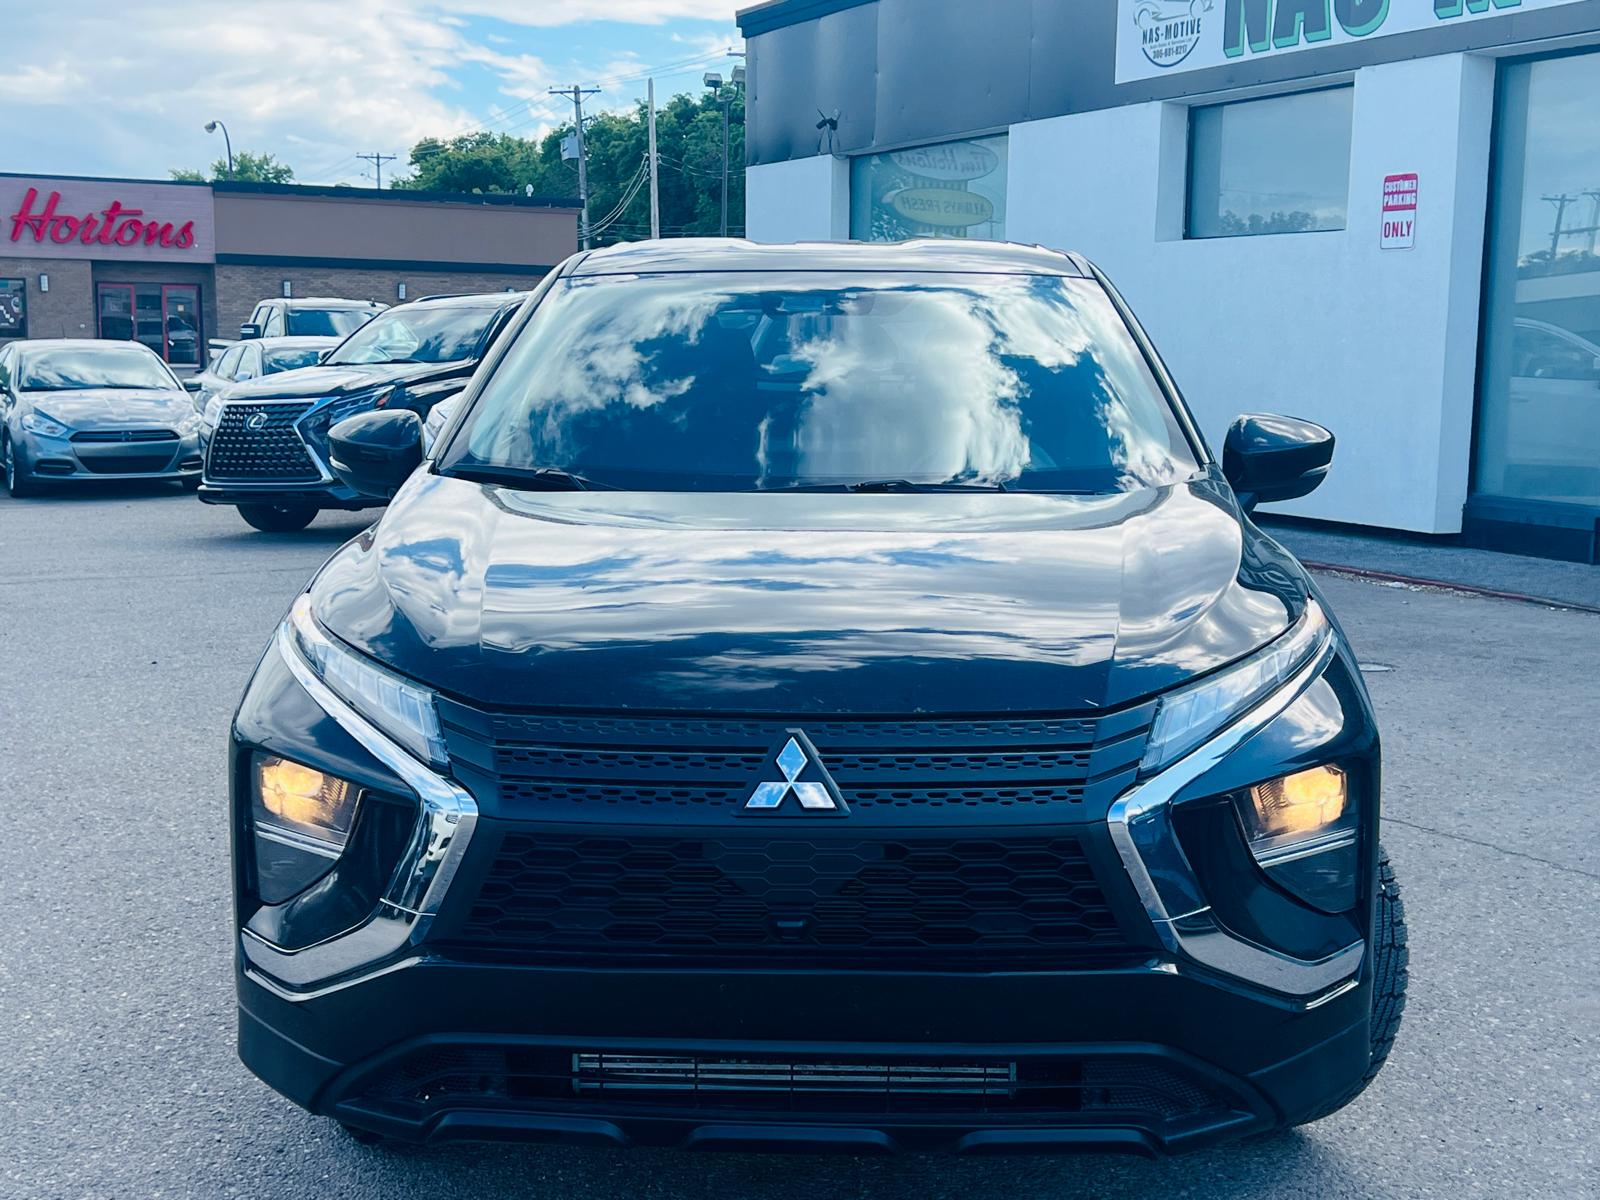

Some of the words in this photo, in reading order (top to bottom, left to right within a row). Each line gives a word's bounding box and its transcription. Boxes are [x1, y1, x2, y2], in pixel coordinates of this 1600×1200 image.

[1142, 17, 1201, 45] NAS-MOTIVE
[1384, 192, 1416, 206] PARKING
[11, 187, 195, 249] Hortons
[1384, 221, 1412, 238] ONLY
